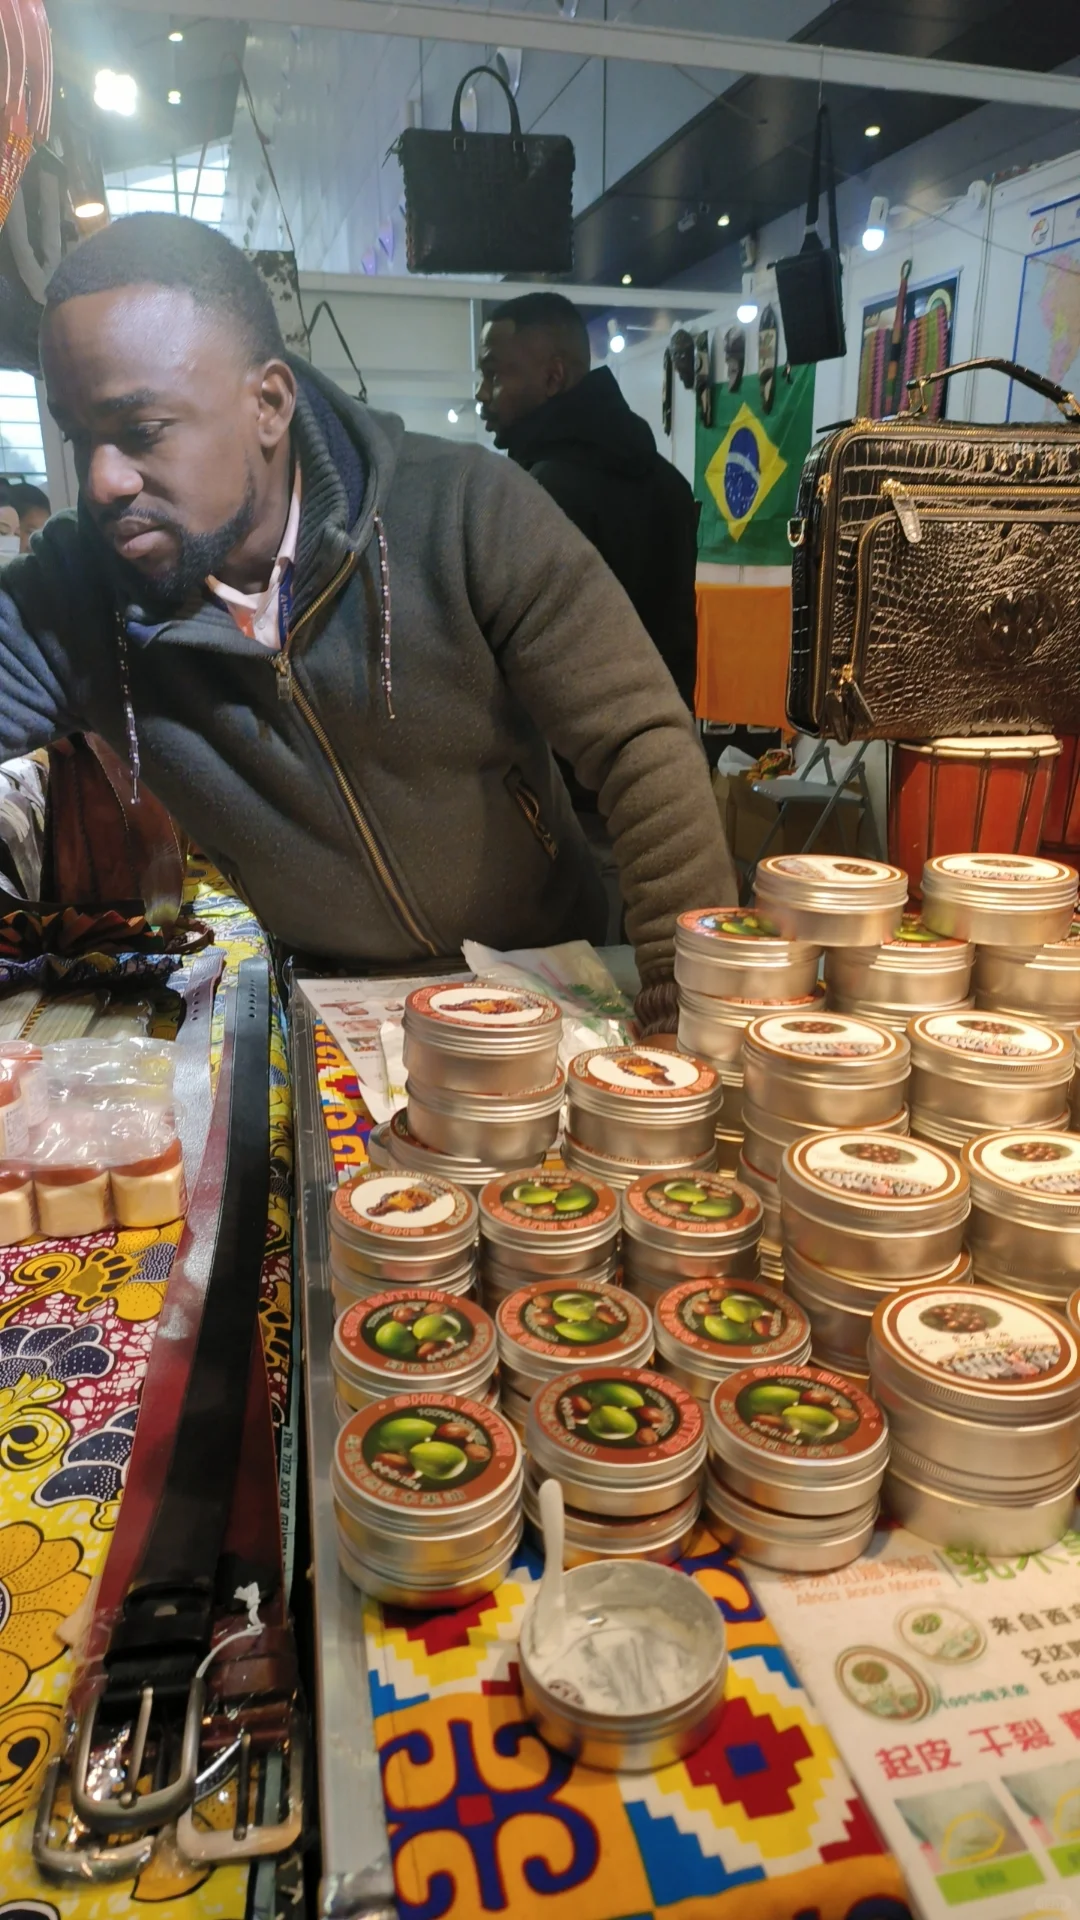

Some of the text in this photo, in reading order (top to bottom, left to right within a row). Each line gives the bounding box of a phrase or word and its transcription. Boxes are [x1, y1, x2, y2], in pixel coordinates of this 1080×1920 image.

[283, 1430, 293, 1449] WAX
[394, 1393, 456, 1407] SHEA
[460, 1401, 515, 1457] BUTTER
[282, 1454, 292, 1476] REAL
[280, 1478, 290, 1509] BLOCK
[875, 1738, 962, 1780] 起皮
[968, 1717, 1056, 1758] 干裂
